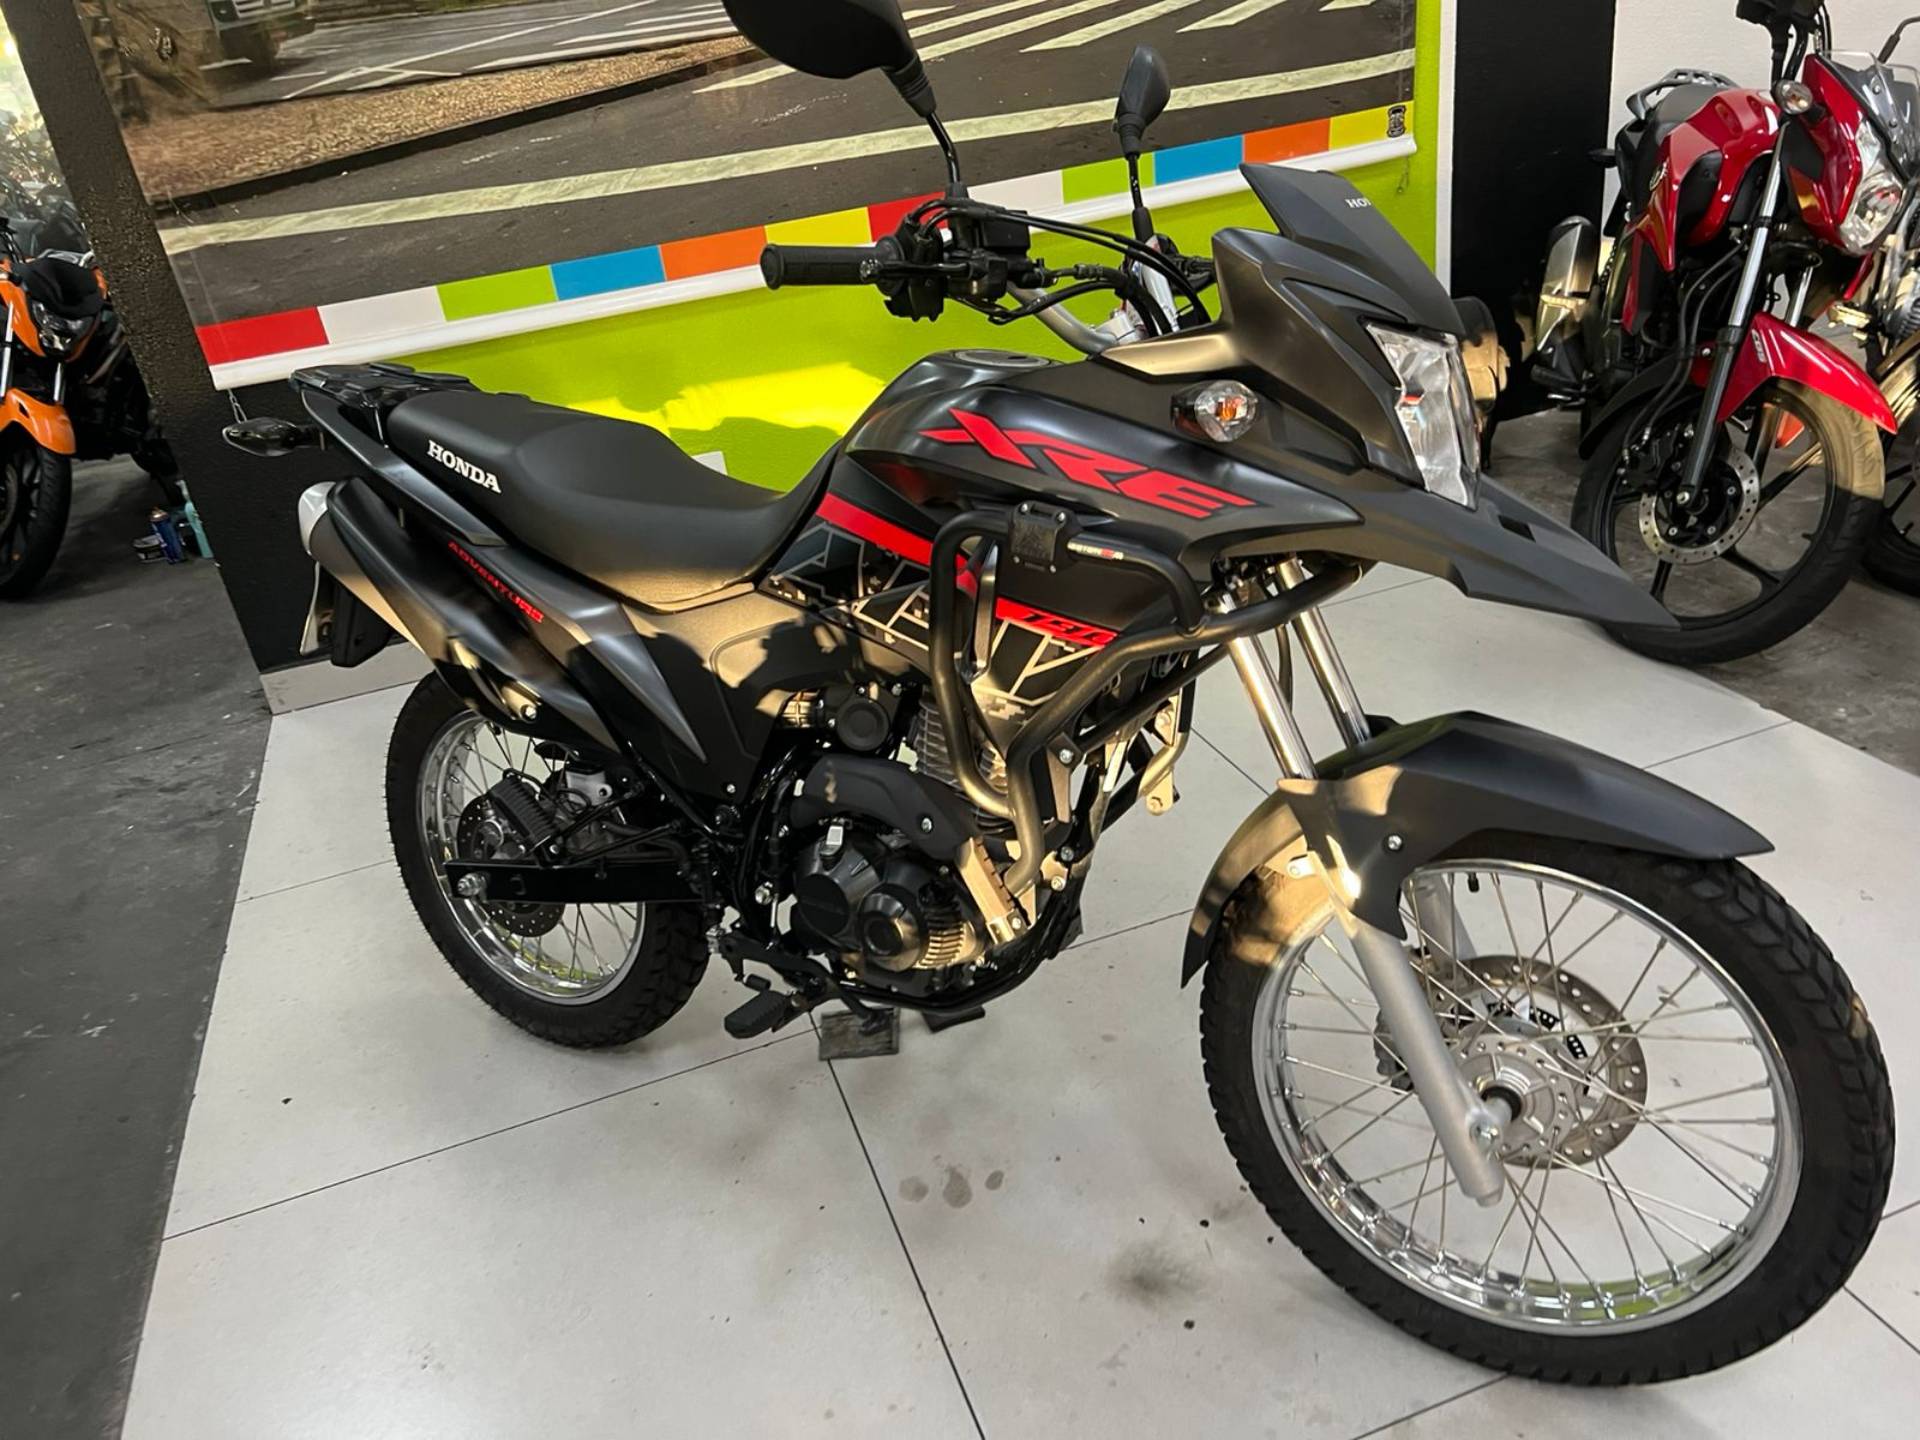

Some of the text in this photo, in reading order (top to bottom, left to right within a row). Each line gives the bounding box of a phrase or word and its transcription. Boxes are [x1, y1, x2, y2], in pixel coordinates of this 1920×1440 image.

[427, 439, 502, 494] HONDA
[918, 407, 1257, 519] XRE
[447, 539, 544, 624] ADVENTURE
